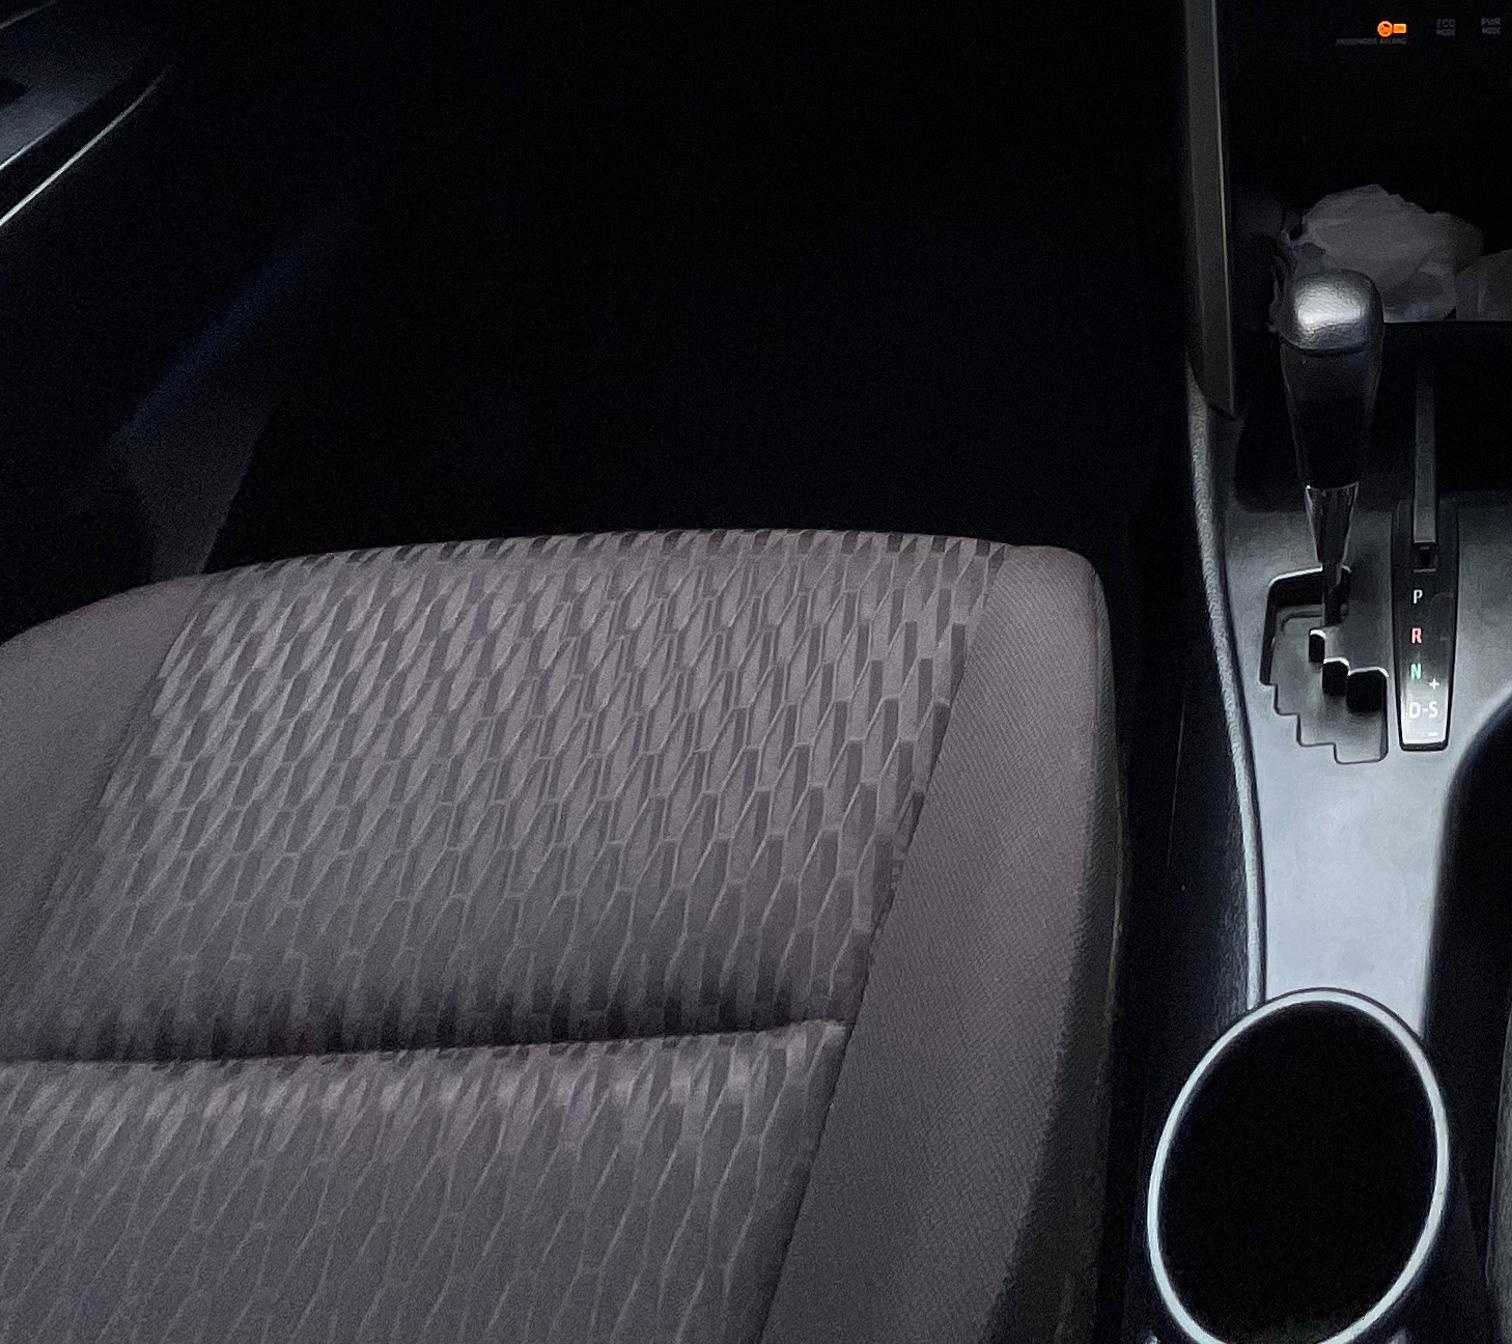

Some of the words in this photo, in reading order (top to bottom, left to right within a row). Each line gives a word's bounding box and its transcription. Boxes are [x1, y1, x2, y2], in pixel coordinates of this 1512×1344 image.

[1412, 588, 1424, 605] P
[1411, 627, 1423, 644] R
[1410, 663, 1423, 680] N
